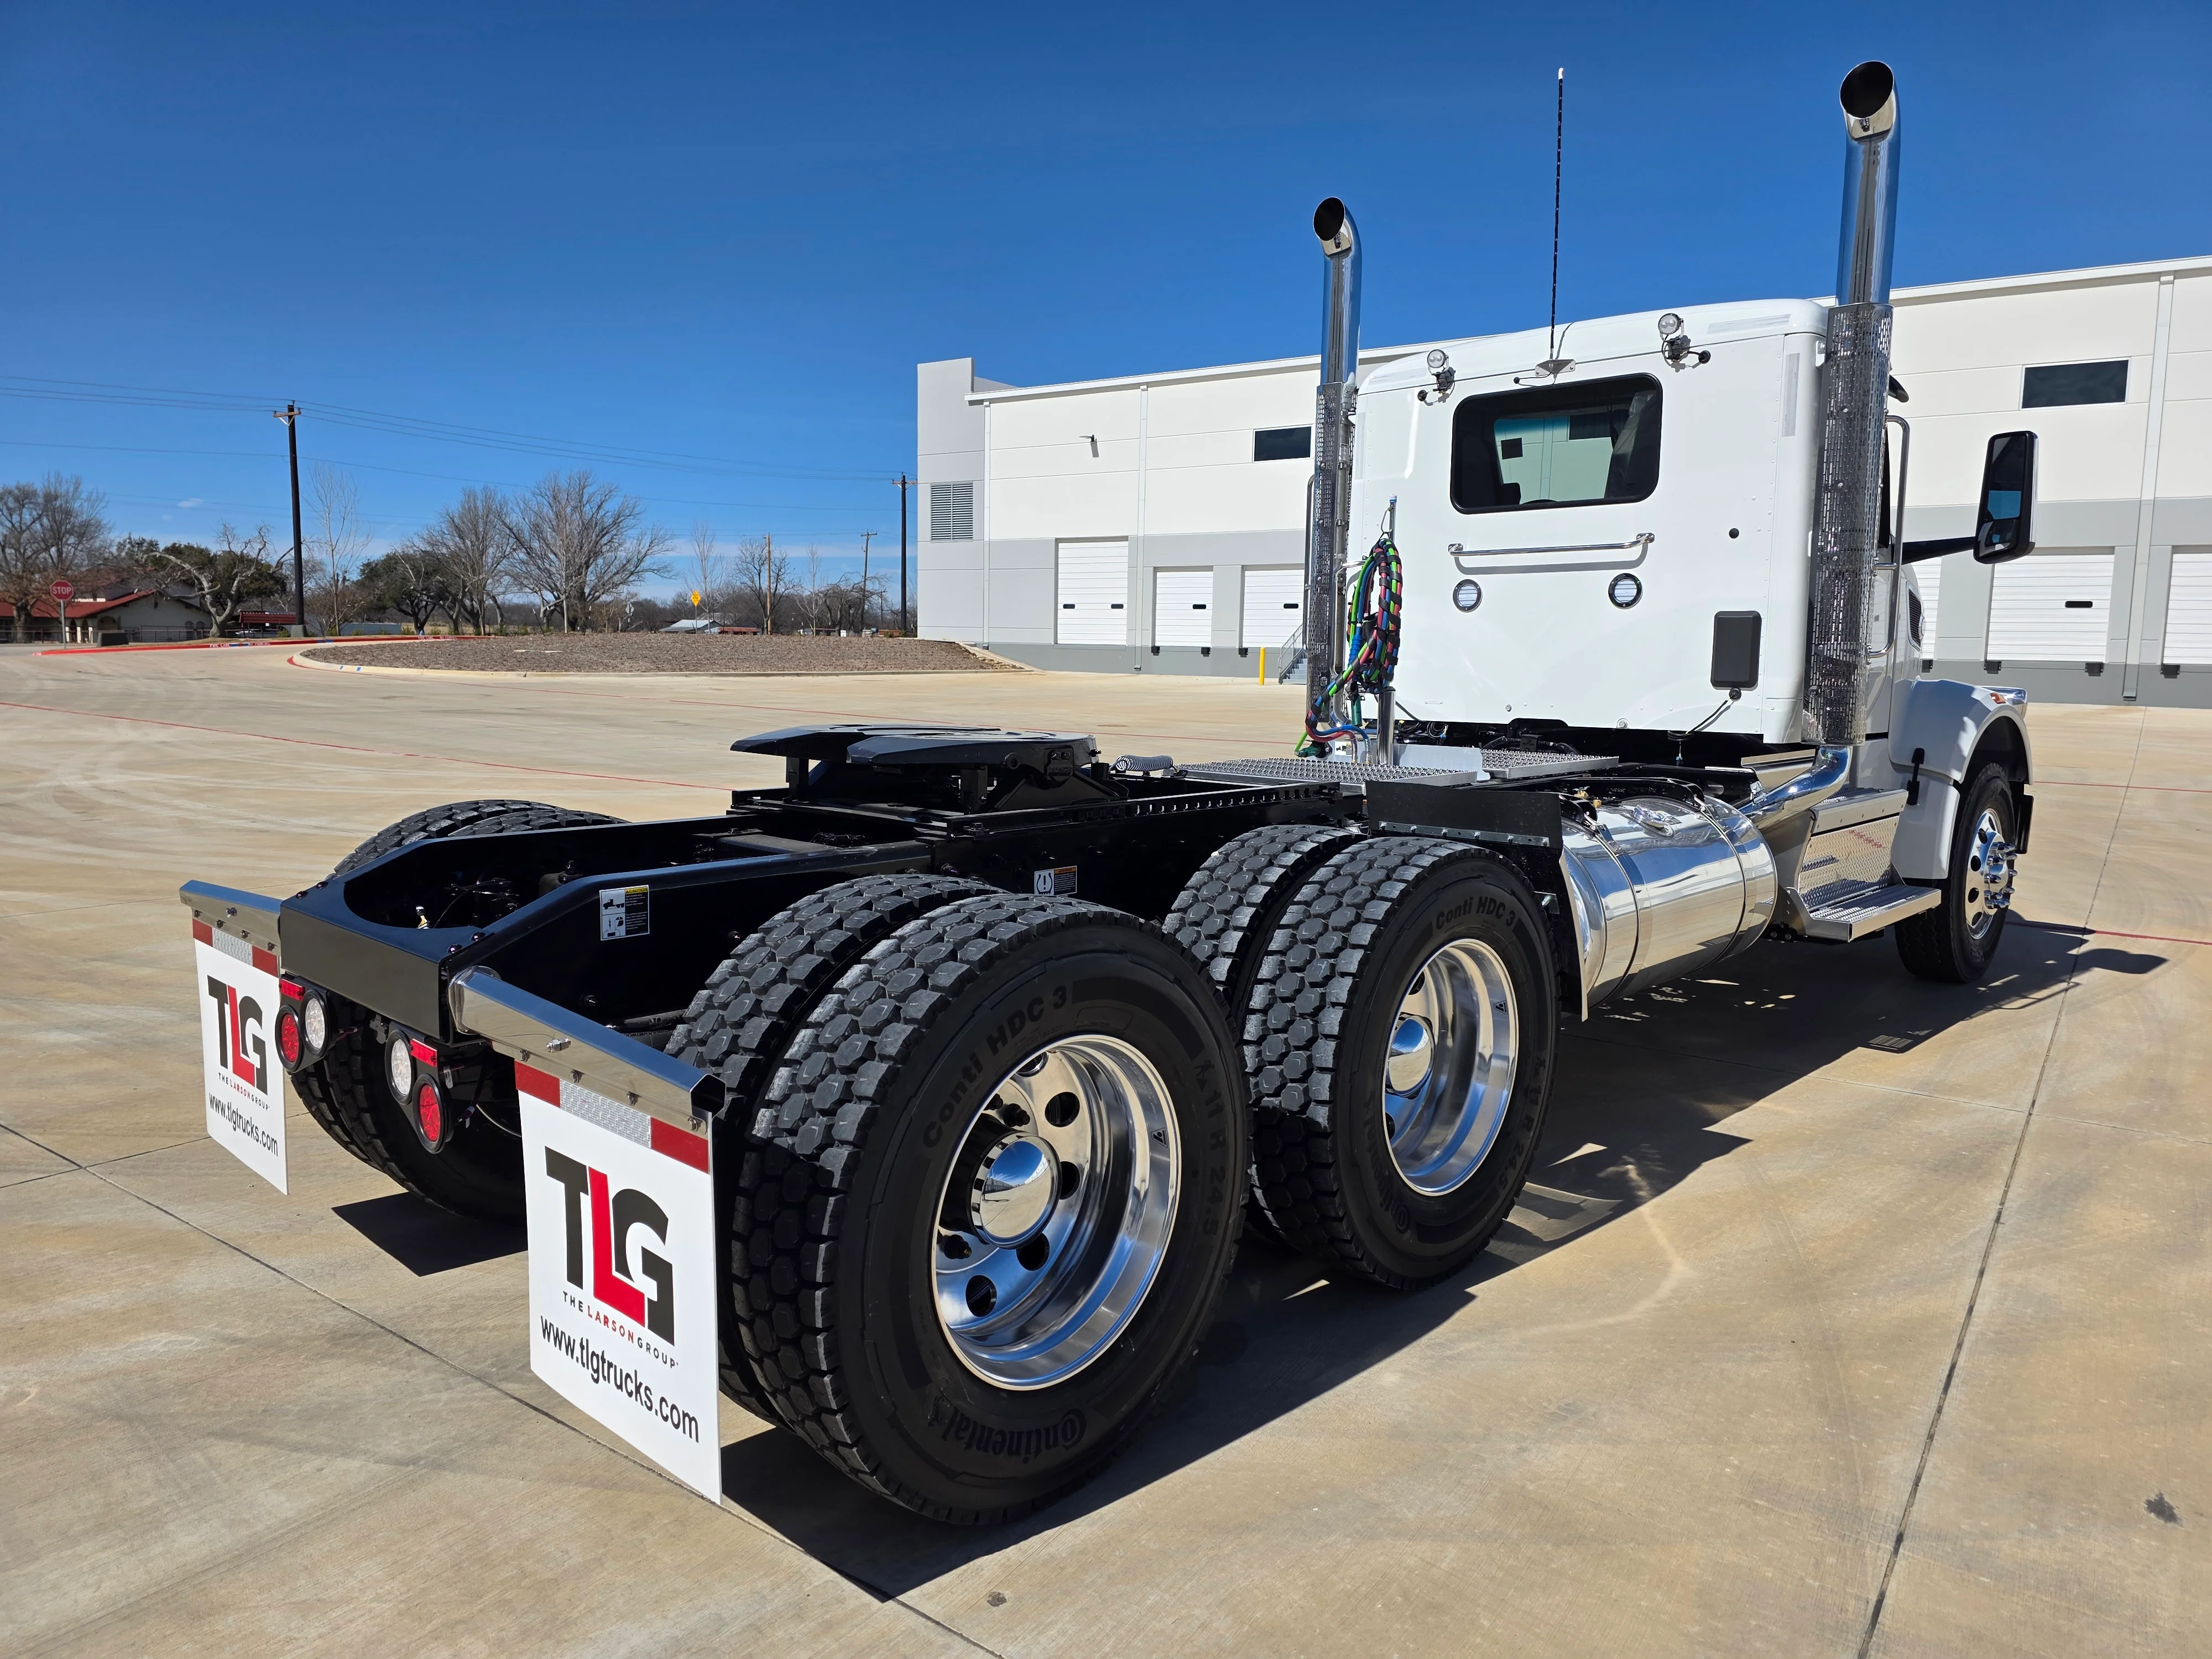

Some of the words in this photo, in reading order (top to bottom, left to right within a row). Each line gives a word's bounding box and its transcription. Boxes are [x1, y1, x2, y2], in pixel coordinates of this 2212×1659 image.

[53, 586, 71, 594] STOP
[1436, 896, 1474, 930] Conti
[1476, 895, 1506, 918] HDC
[1506, 910, 1516, 927] 3
[207, 974, 268, 1095] TLG
[923, 1052, 983, 1148] Conti
[986, 997, 1044, 1056] HDC
[1052, 985, 1067, 1010] 3
[209, 1093, 278, 1157] www.tlgtrucks.com
[218, 1072, 228, 1085] THE
[230, 1079, 251, 1099] LARSON
[251, 1094, 268, 1110] GROUP
[1202, 1166, 1226, 1235] 24.5
[545, 1146, 675, 1346] TLG
[563, 1291, 583, 1312] THE
[587, 1305, 634, 1343] LARSON
[637, 1337, 675, 1369] GROUP
[540, 1315, 699, 1443] www.tlgtrucks.com
[941, 1407, 1087, 1464] Continental
